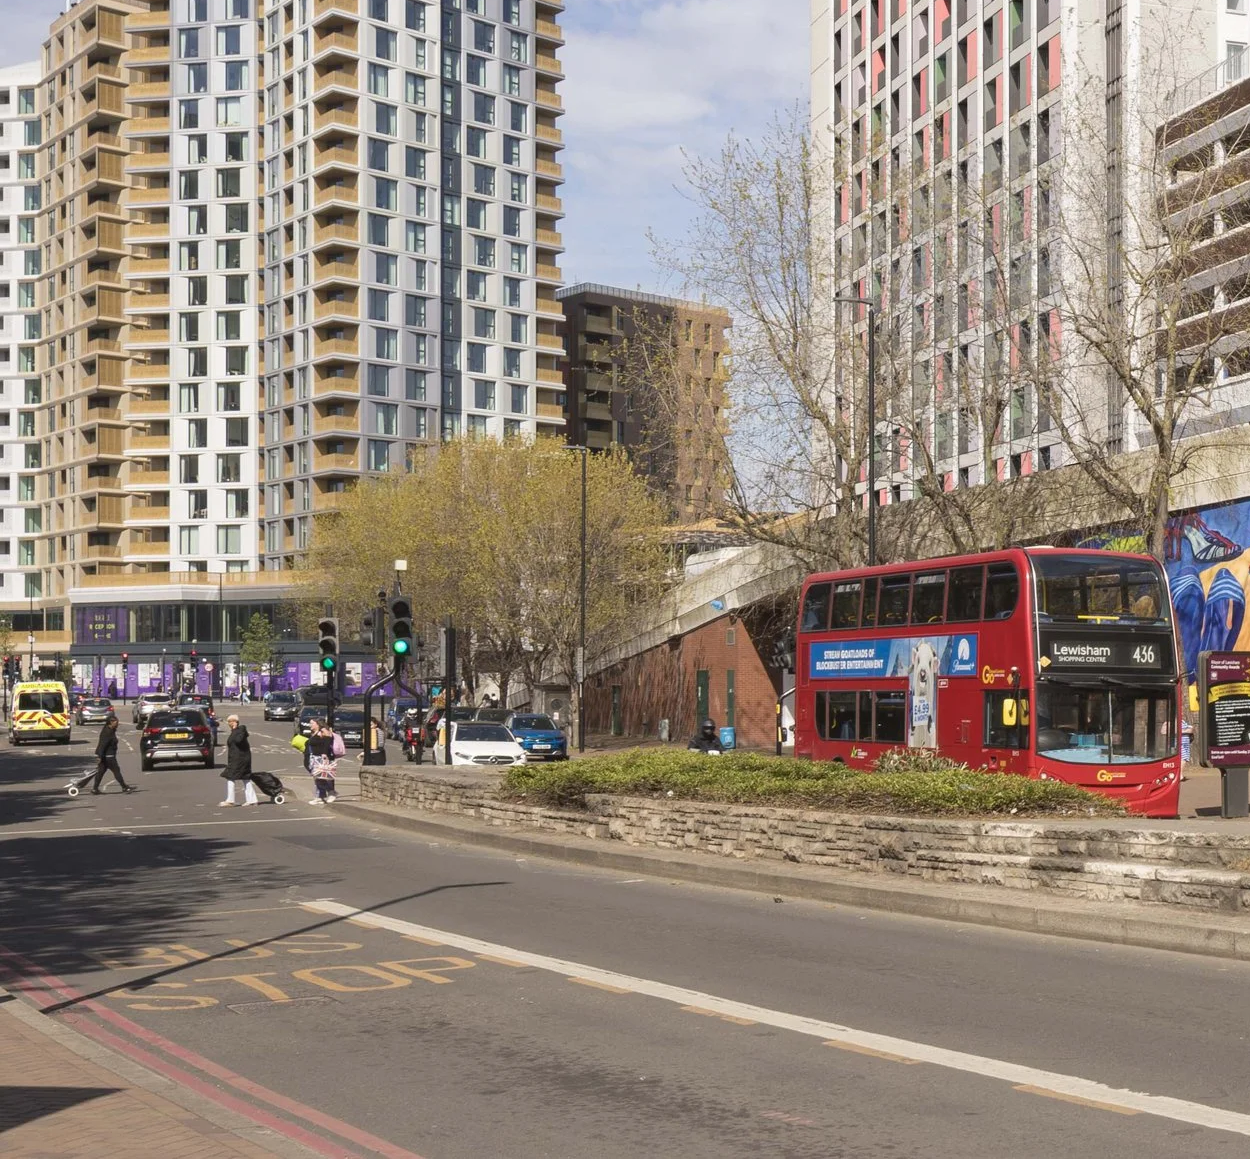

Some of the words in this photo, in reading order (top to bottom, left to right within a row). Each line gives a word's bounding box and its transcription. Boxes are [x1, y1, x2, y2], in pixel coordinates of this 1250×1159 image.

[1054, 643, 1111, 656] Lewisham
[1132, 645, 1154, 663] 436
[816, 661, 847, 670] BLOCKBUSTER
[847, 659, 884, 669] ENTERTAINMENT
[105, 934, 362, 971] BUS
[107, 956, 476, 1011] STOP
